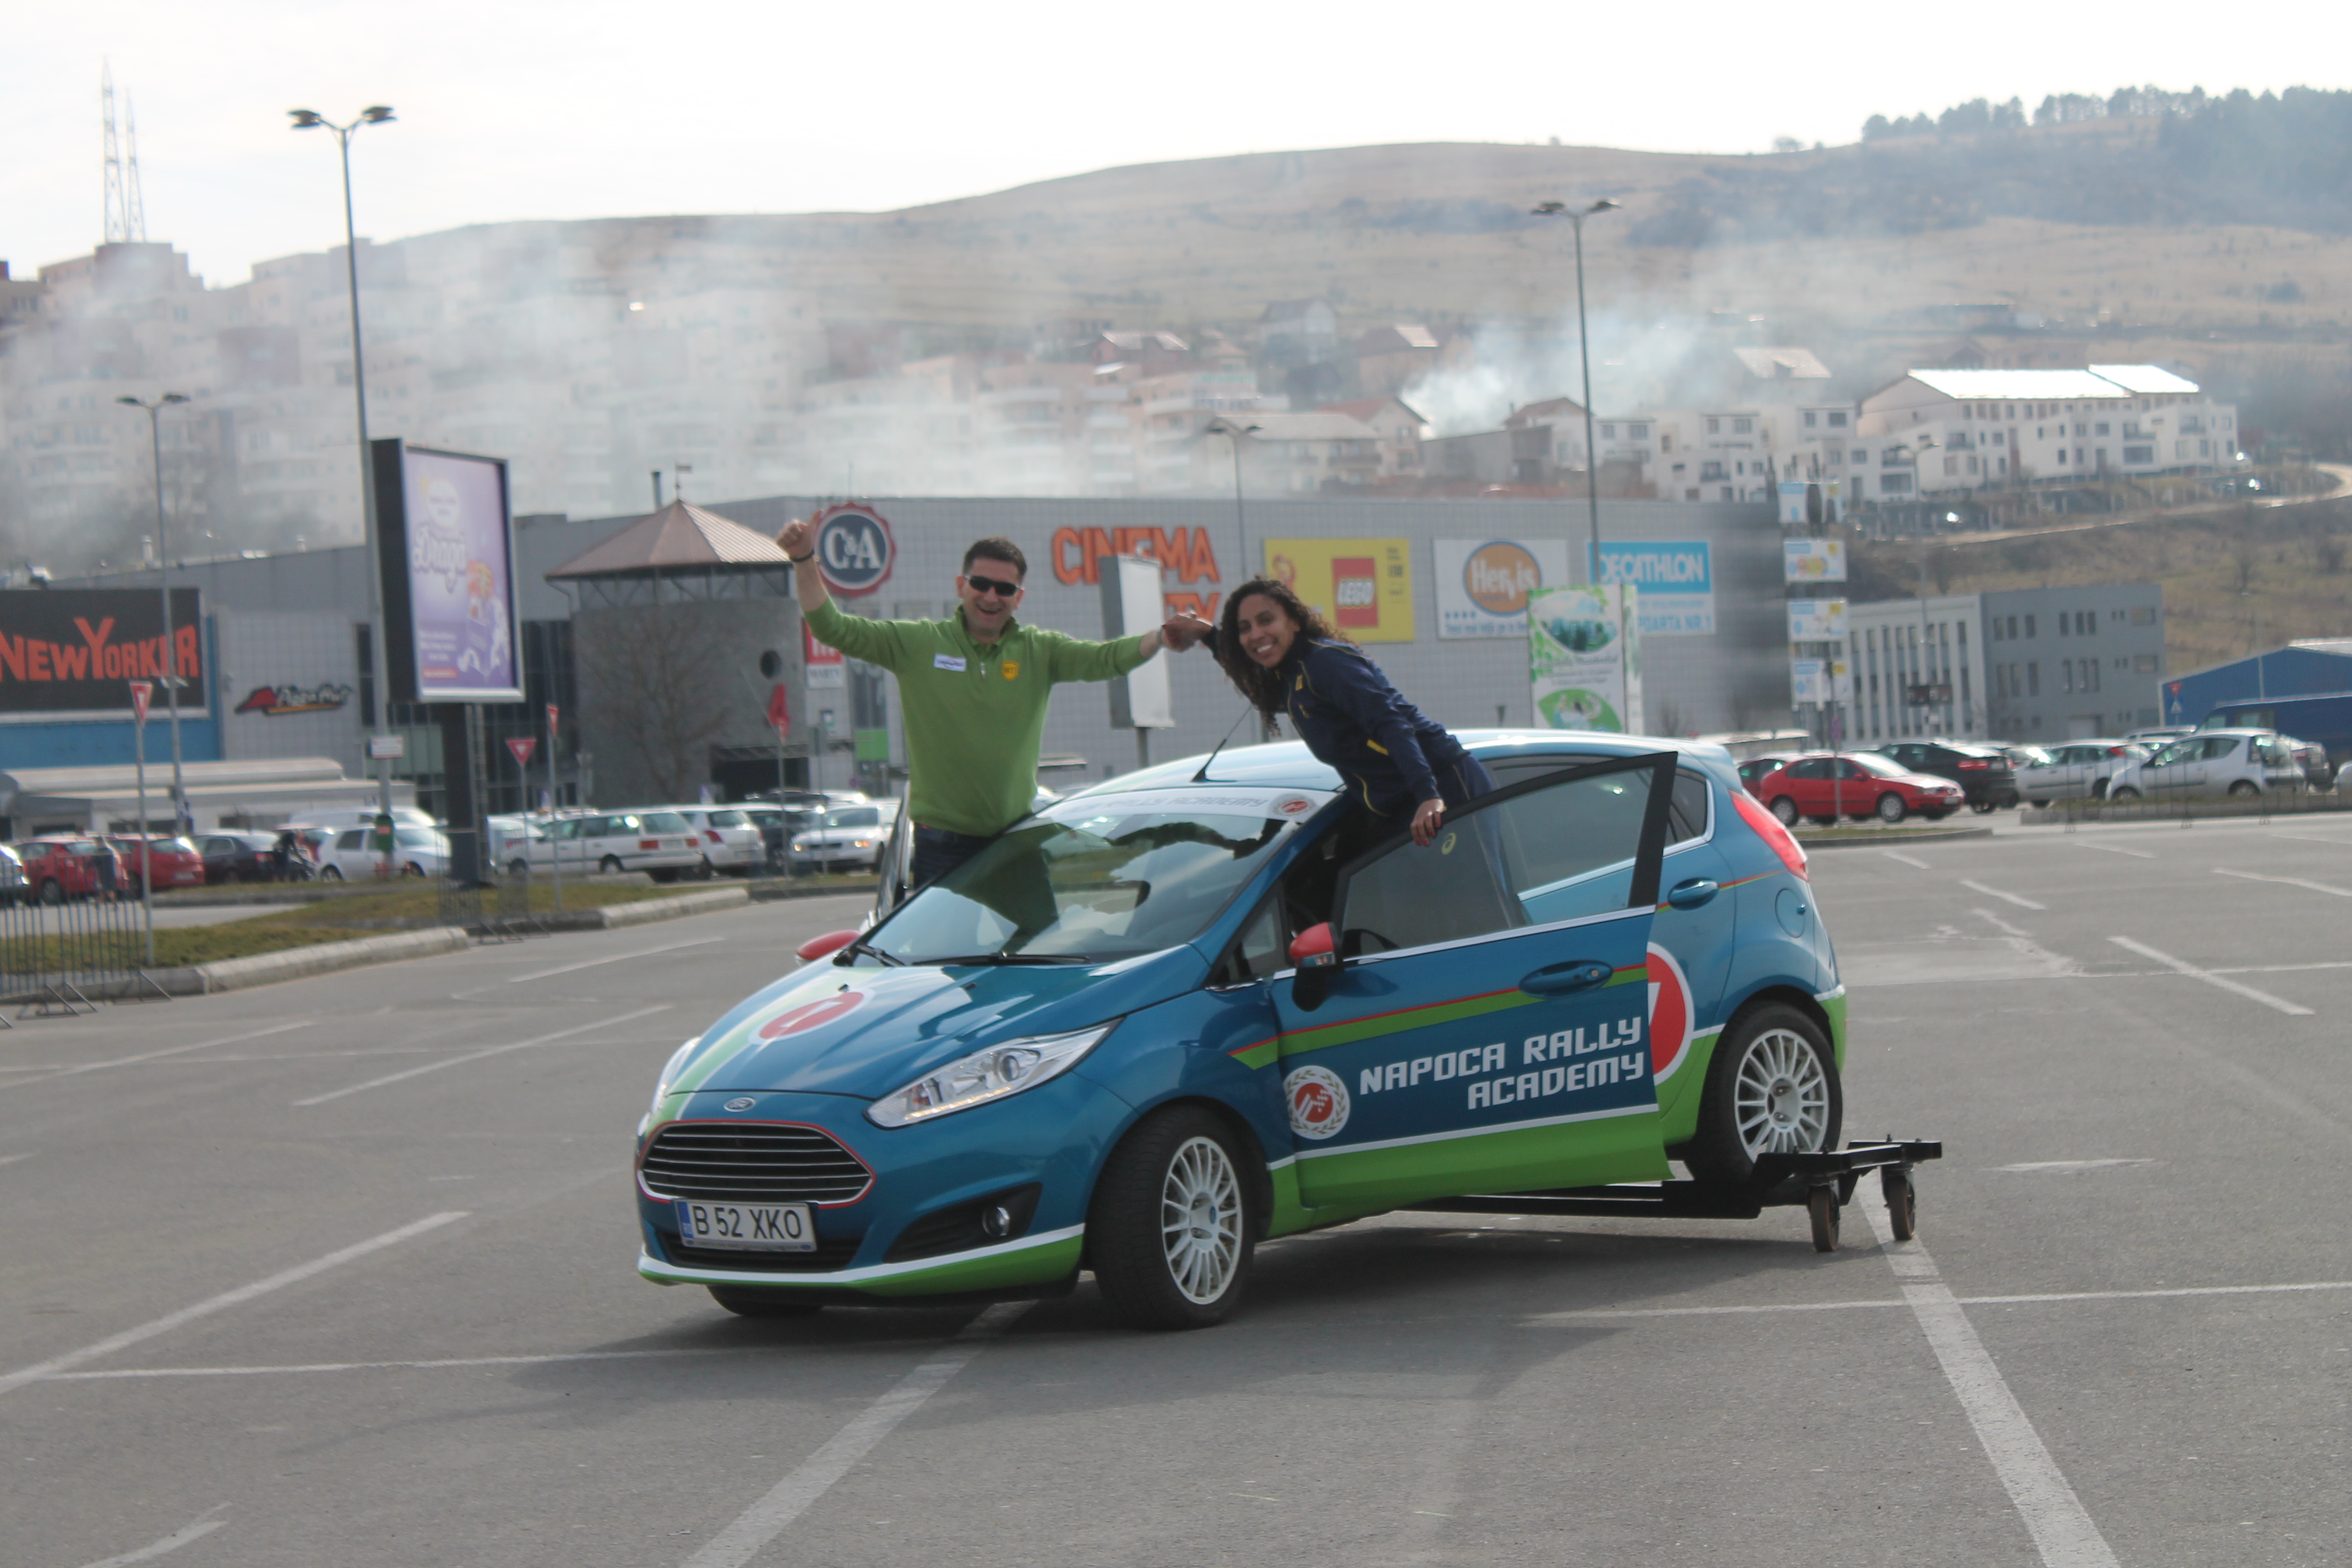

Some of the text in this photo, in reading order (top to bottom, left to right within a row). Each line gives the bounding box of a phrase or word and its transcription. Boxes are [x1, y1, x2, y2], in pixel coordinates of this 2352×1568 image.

[824, 526, 881, 569] C&A
[1470, 559, 1536, 599] Hervis
[1598, 554, 1705, 584] DECATHLON
[1336, 579, 1375, 606] LEGO
[1360, 1016, 1641, 1095] NAPOCA RALLY
[1468, 1052, 1645, 1110] ACADEMY
[693, 1206, 802, 1239] B 52 XKO
